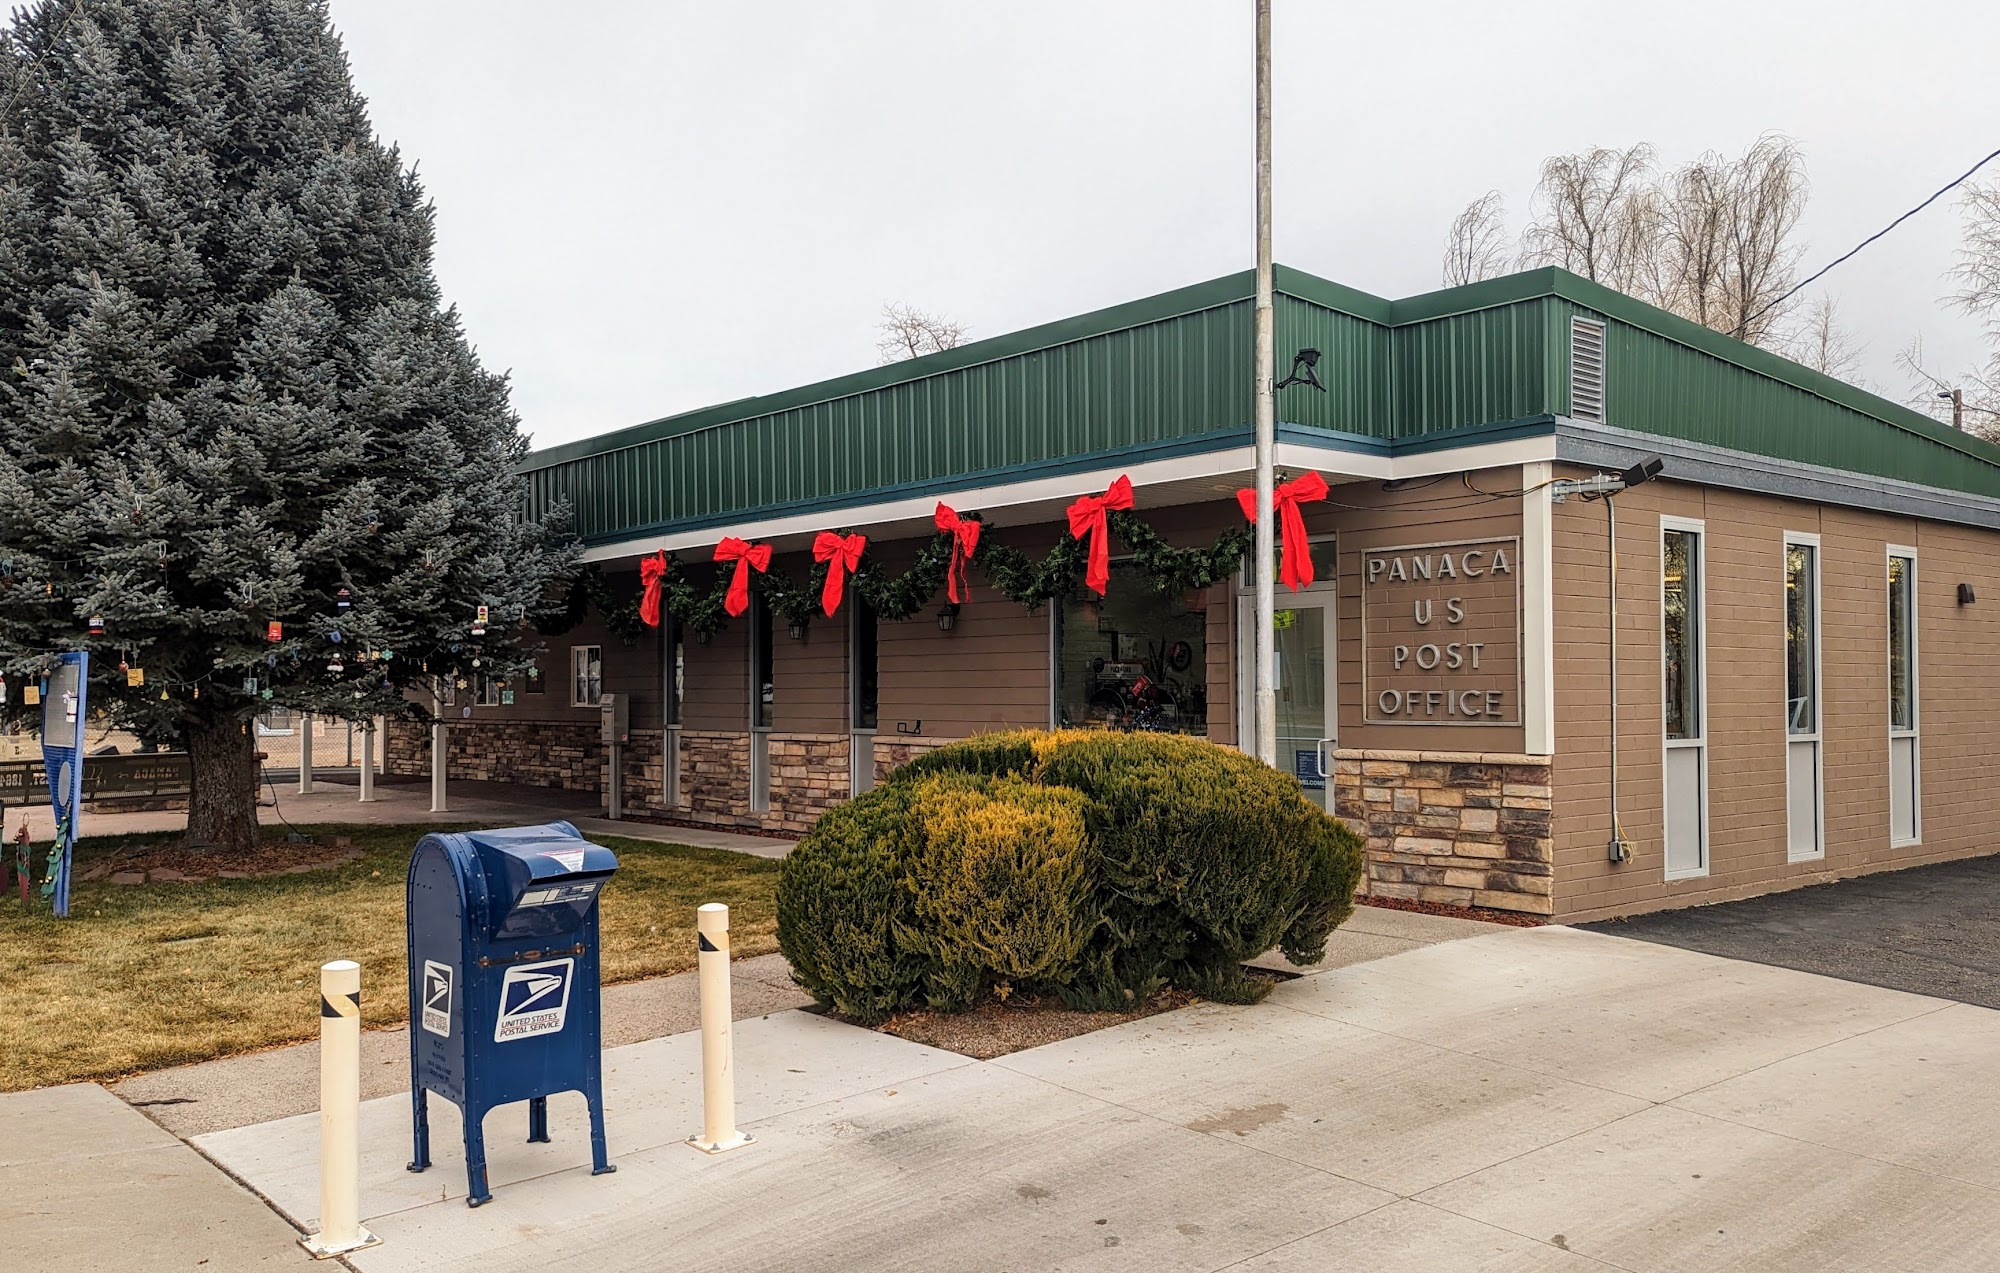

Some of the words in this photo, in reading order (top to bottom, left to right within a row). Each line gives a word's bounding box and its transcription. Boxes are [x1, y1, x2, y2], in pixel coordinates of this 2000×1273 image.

[1369, 549, 1511, 583] PANACA
[1414, 599, 1432, 625] U
[1446, 597, 1464, 624] S
[1394, 642, 1484, 670] POST
[1378, 689, 1503, 716] OFFICE
[500, 1026, 528, 1038] POSTAL
[529, 1020, 560, 1032] SERVICE
[501, 1017, 531, 1029] UNITED
[531, 1012, 558, 1023] STATES
